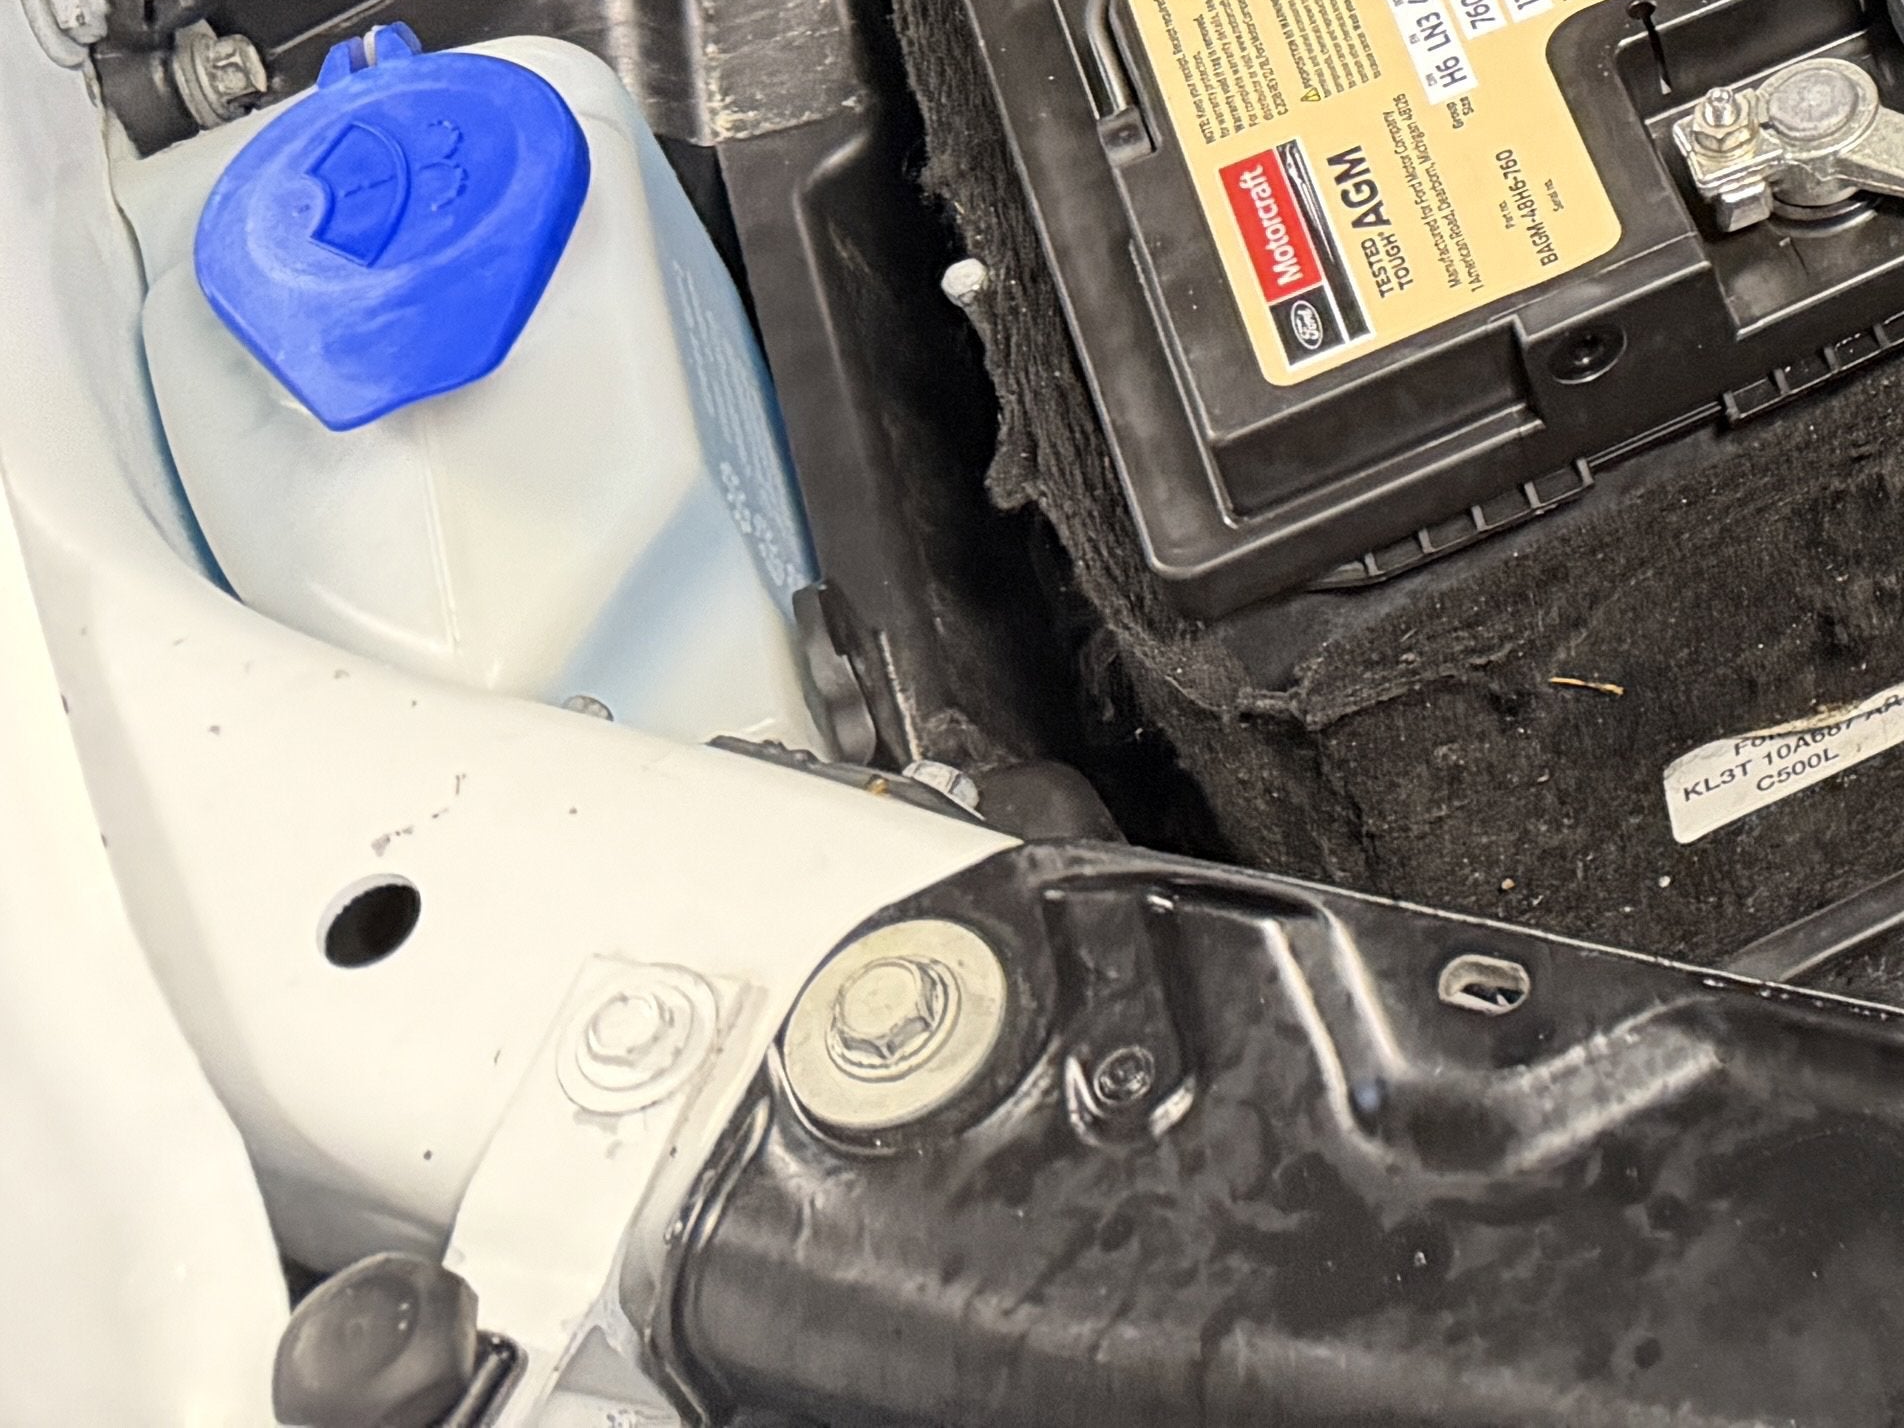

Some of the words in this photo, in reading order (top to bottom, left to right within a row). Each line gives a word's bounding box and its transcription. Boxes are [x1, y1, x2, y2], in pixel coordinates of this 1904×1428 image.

[1414, 10, 1452, 52] LN3
[1434, 54, 1468, 88] H6
[1391, 92, 1414, 122] 48126
[1444, 100, 1464, 130] Group
[1458, 94, 1474, 116] Size
[1380, 108, 1408, 155] Company
[1404, 120, 1432, 165] Michigan
[1325, 143, 1392, 234] AGM
[1398, 152, 1419, 184] Motor
[1408, 180, 1428, 206] Ford
[1418, 203, 1434, 220] for
[1494, 146, 1558, 268] BAGM-48H6-760
[1238, 162, 1304, 286] Motorcraft
[1440, 208, 1463, 240] Road,
[1500, 210, 1516, 230] Part
[1359, 236, 1395, 299] TESTED
[1422, 216, 1462, 290] Manufactured
[1452, 236, 1482, 286] American
[1291, 304, 1321, 345] Ford
[1684, 760, 1753, 801] KL3T
[1757, 747, 1839, 792] C500L
